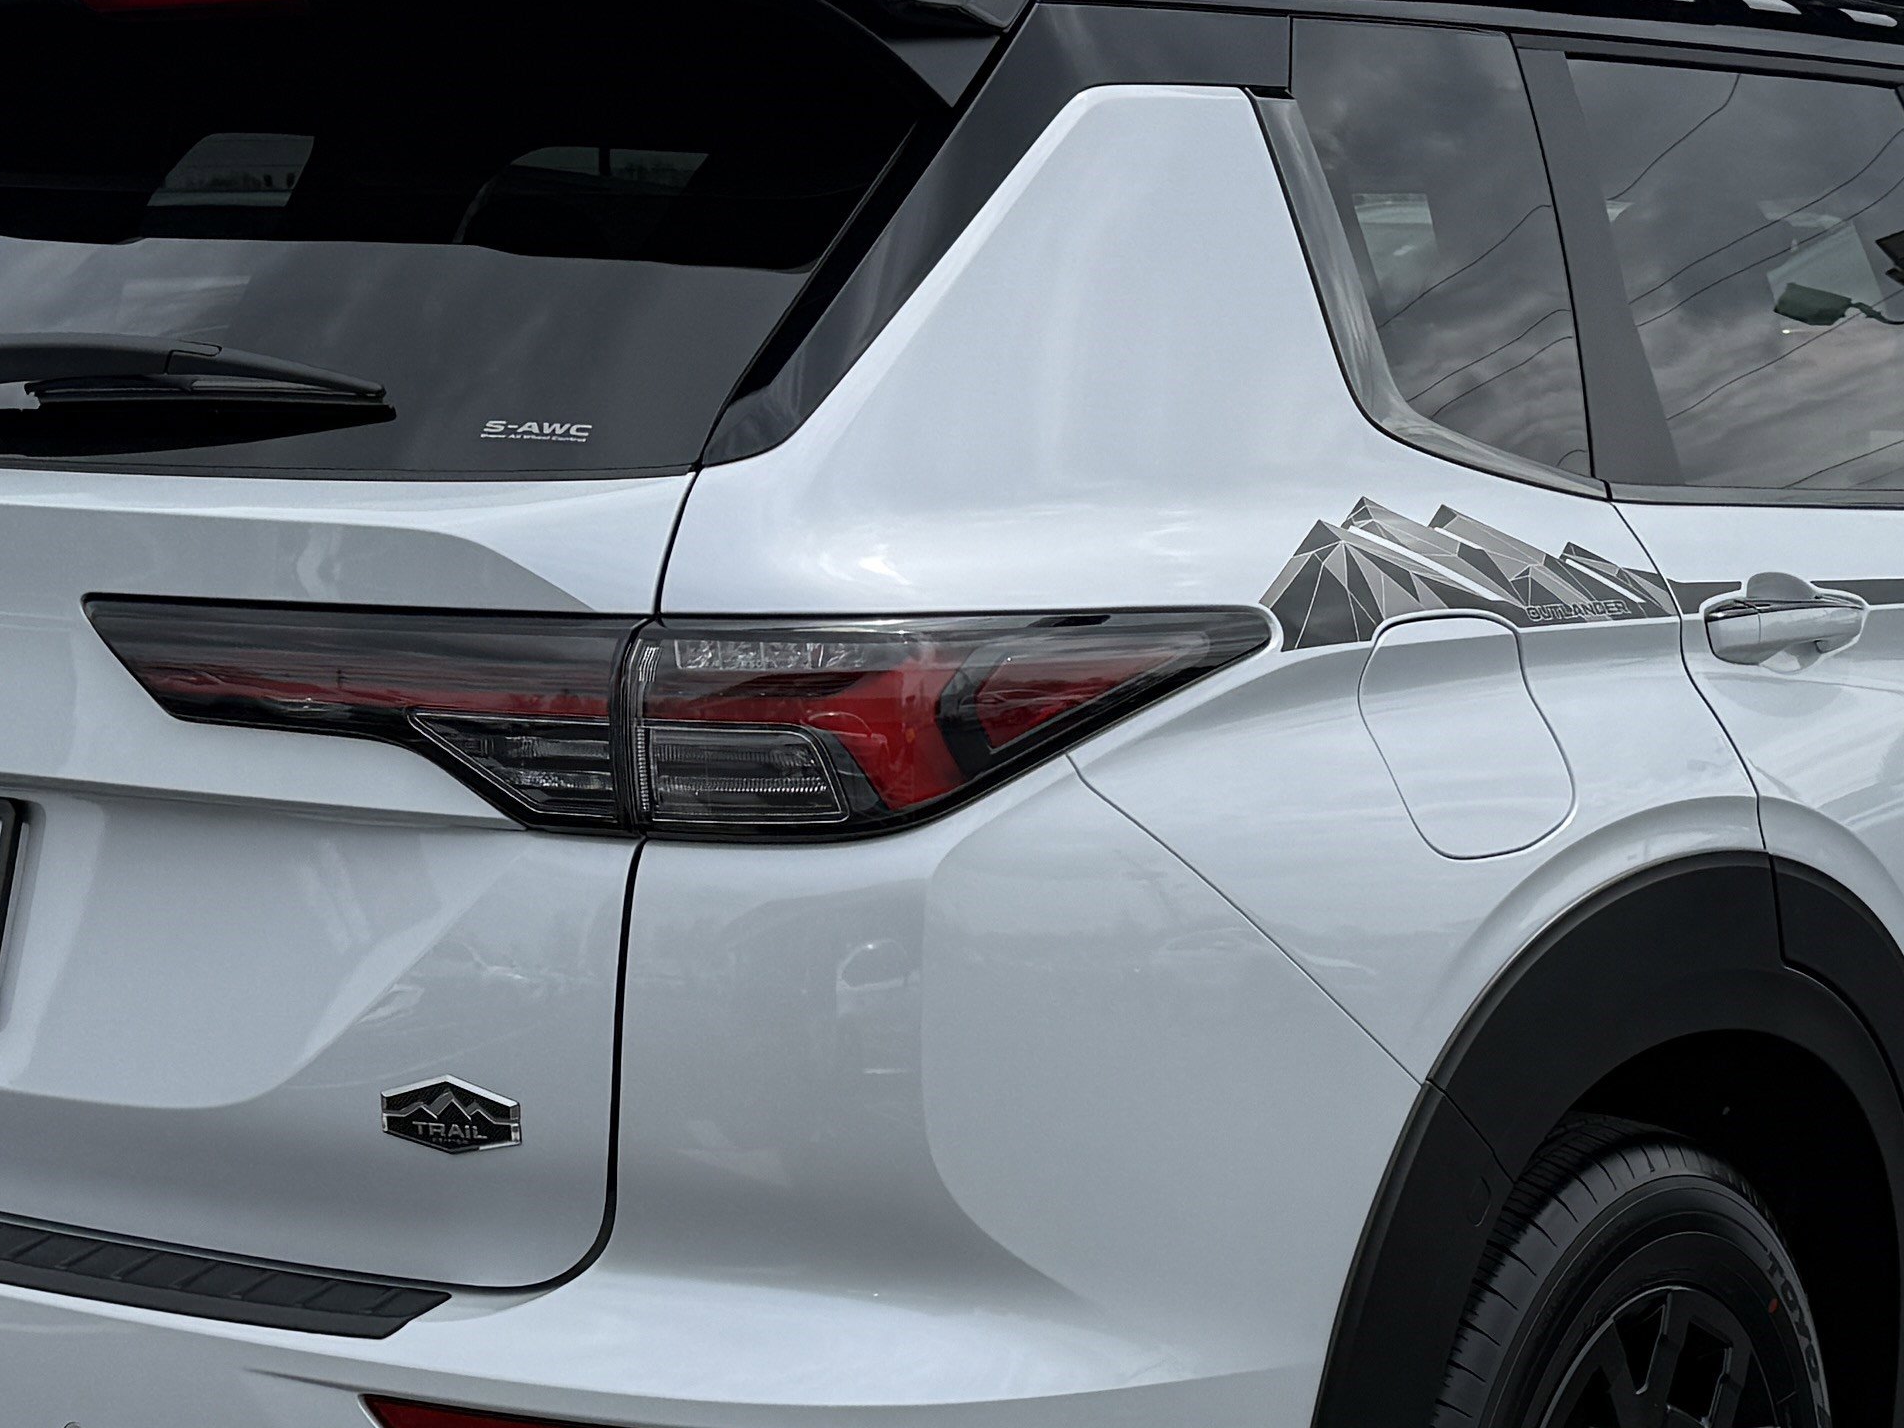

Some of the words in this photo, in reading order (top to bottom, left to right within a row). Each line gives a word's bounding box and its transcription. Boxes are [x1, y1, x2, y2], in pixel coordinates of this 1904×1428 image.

[483, 420, 593, 437] S-AWC
[1525, 599, 1632, 622] OUTLANDER
[412, 1121, 488, 1140] TRAIL
